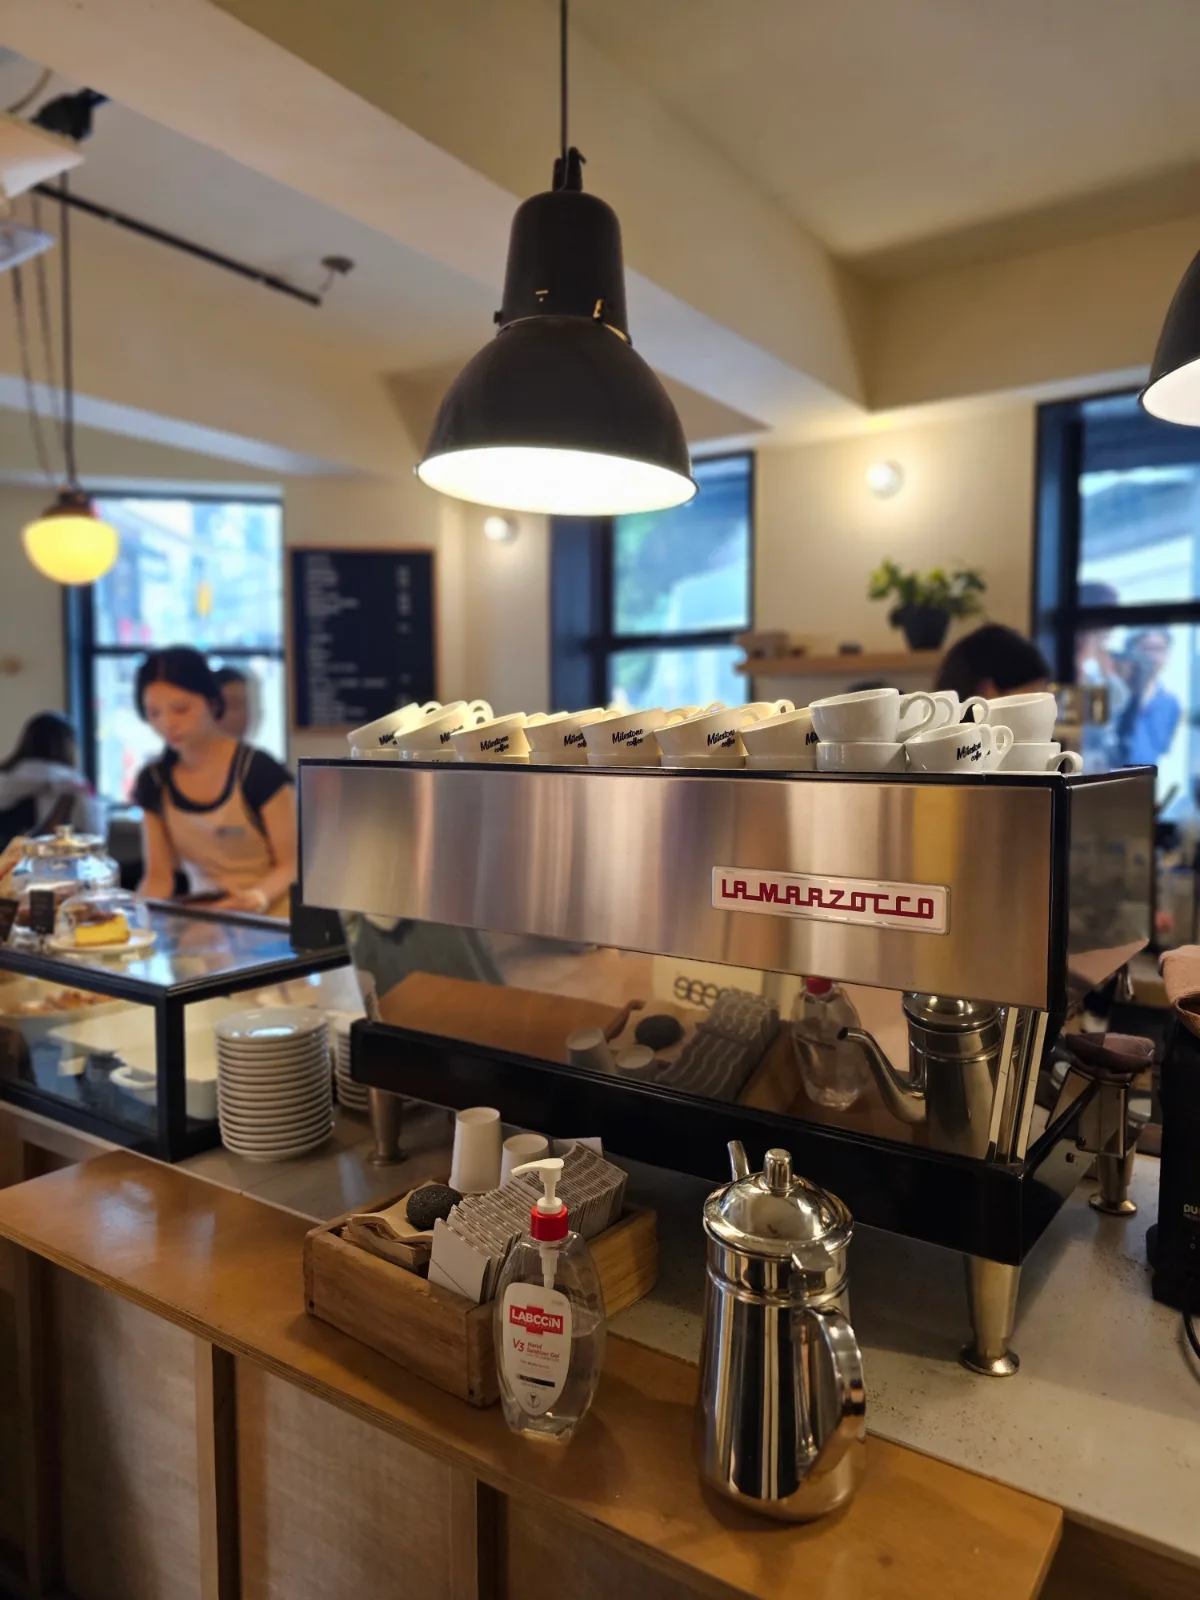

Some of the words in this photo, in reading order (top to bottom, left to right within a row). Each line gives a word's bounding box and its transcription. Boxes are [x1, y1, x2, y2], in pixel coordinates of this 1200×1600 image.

[480, 735, 509, 751] Milestone
[612, 728, 643, 744] Milestone
[626, 737, 643, 747] coffee
[707, 729, 736, 746] Milestone
[721, 738, 736, 748] coffee
[494, 743, 509, 753] coffee
[512, 1338, 525, 1352] V3
